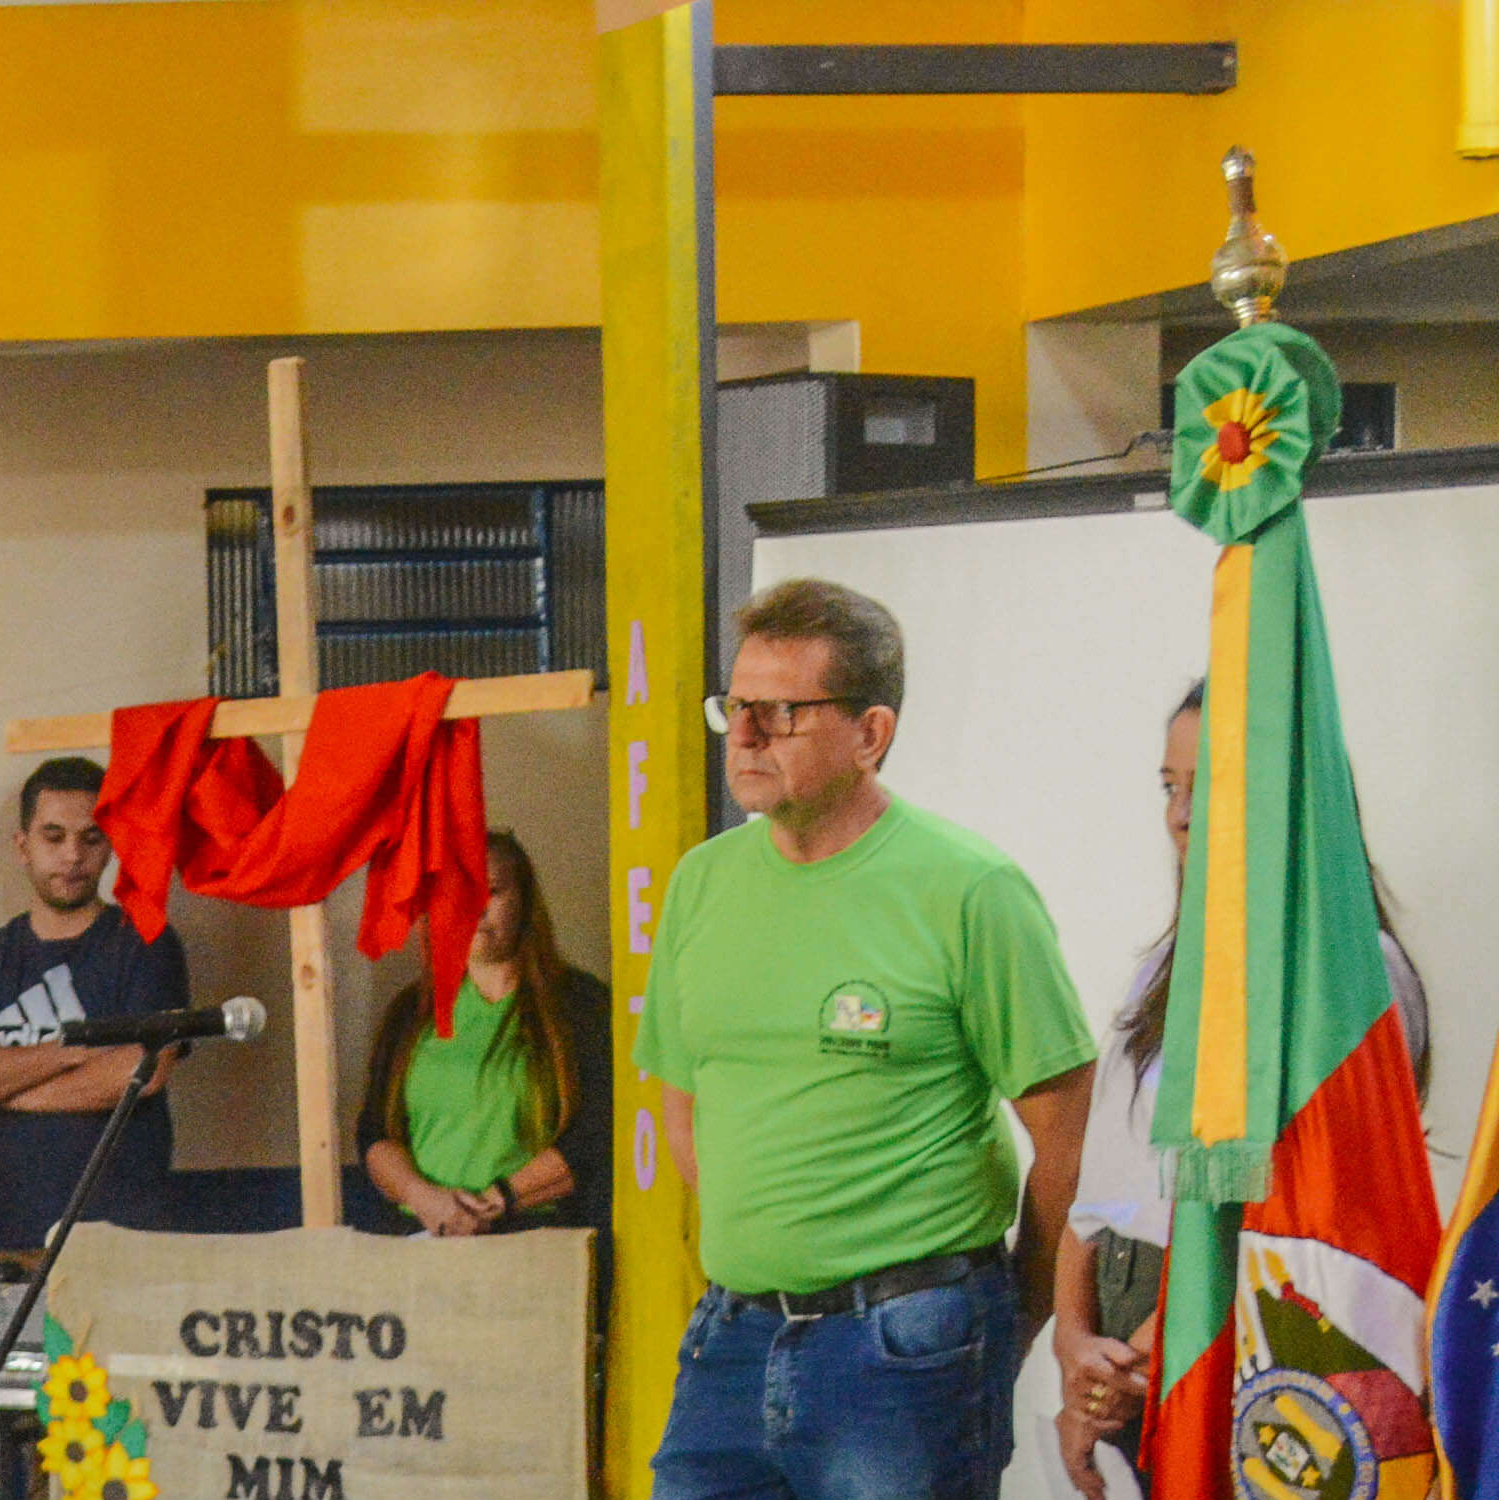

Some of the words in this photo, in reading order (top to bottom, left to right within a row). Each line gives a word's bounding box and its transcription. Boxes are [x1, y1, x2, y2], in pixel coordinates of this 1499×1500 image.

[625, 619, 657, 1191] AFEO
[180, 1310, 406, 1359] CRISTO
[152, 1380, 303, 1433] VIVE
[355, 1386, 446, 1439] EM
